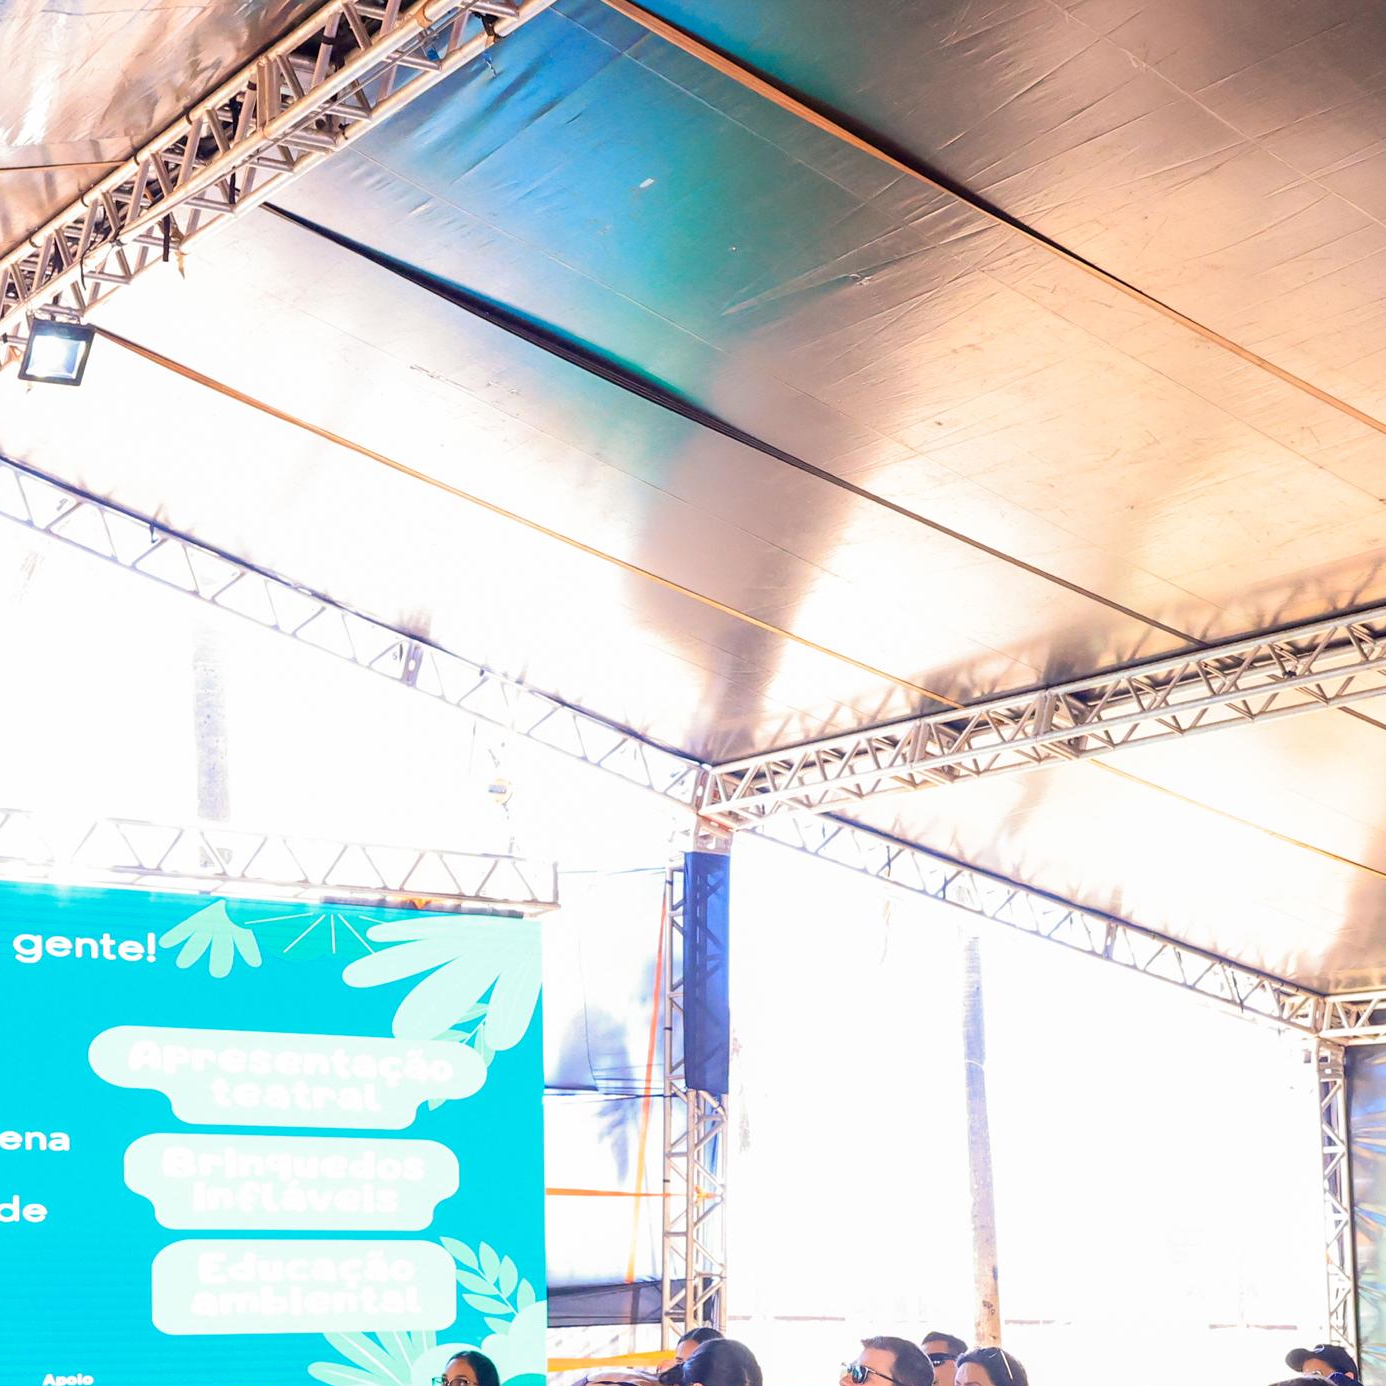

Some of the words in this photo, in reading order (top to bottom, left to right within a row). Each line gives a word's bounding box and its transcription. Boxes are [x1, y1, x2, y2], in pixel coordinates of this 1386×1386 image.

[13, 933, 156, 963] gente!
[128, 1041, 454, 1083] Apresentação
[212, 1078, 384, 1113] teatral
[161, 1146, 426, 1182] Brinquedos
[197, 1251, 416, 1290] Educação
[191, 1284, 421, 1317] ambiental
